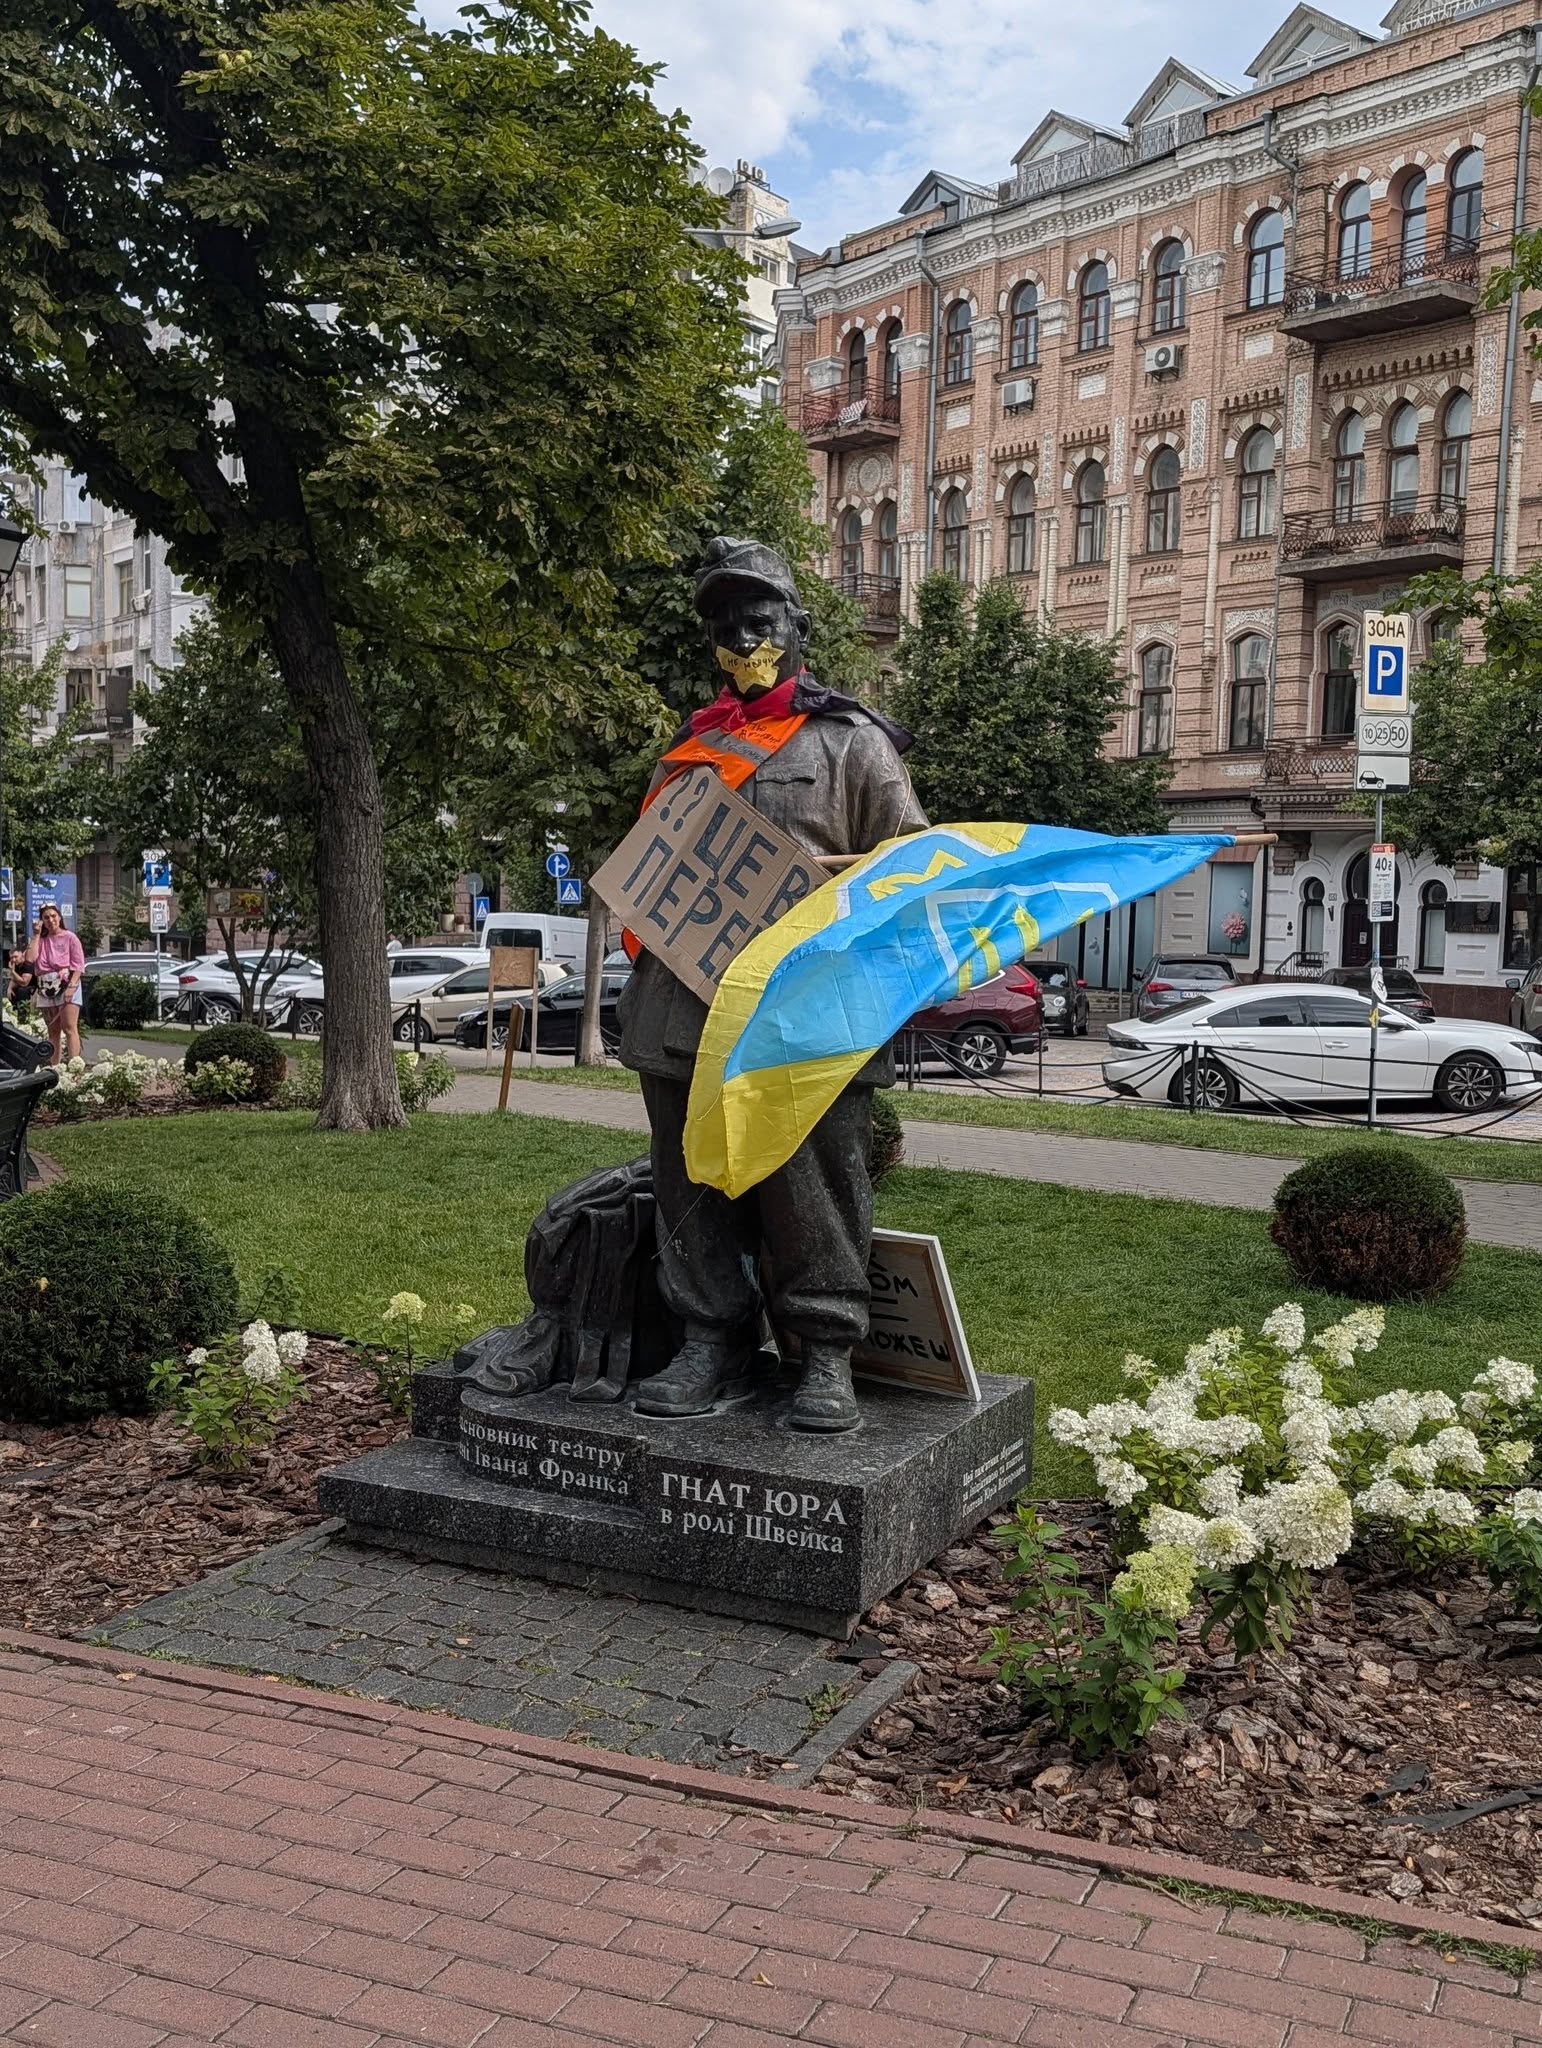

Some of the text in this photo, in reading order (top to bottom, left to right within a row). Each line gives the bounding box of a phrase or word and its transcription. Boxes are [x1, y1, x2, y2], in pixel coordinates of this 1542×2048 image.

[1367, 618, 1406, 639] ЗОНА
[1376, 649, 1398, 691] P
[1363, 725, 1406, 741] 10 25 50
[621, 833, 765, 985] ПЕРЕ
[475, 1445, 529, 1476] Івана
[539, 1458, 629, 1495] Франка
[548, 1438, 625, 1471] театру
[661, 1472, 848, 1525] ГНАТ ЮРА
[661, 1508, 844, 1554] в ролі Швейка
